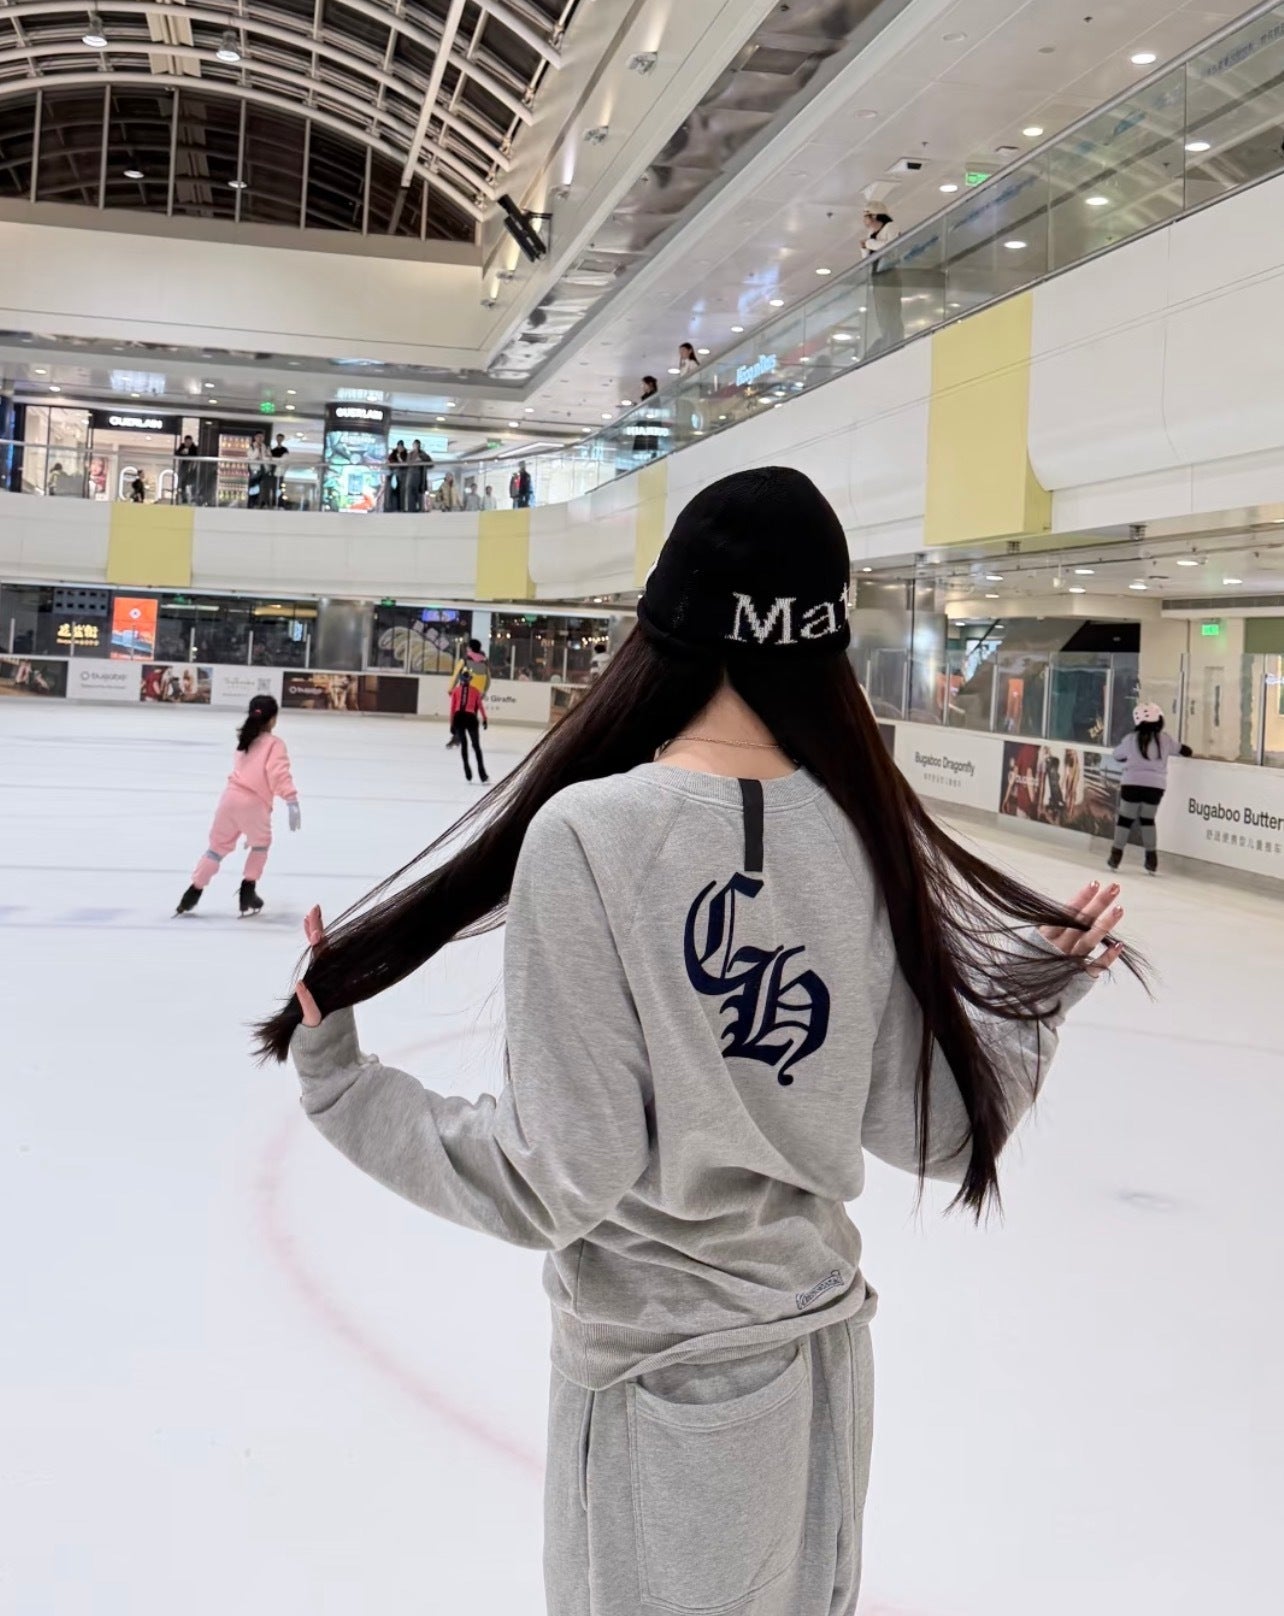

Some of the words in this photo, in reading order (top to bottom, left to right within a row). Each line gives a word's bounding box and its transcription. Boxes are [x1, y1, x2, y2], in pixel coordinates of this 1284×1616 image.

[490, 694, 517, 704] Giraffe
[915, 751, 942, 769] Bugaboo
[942, 756, 976, 777] Dragonfly
[1188, 797, 1241, 822] Bugaboo
[1243, 807, 1284, 831] Butter
